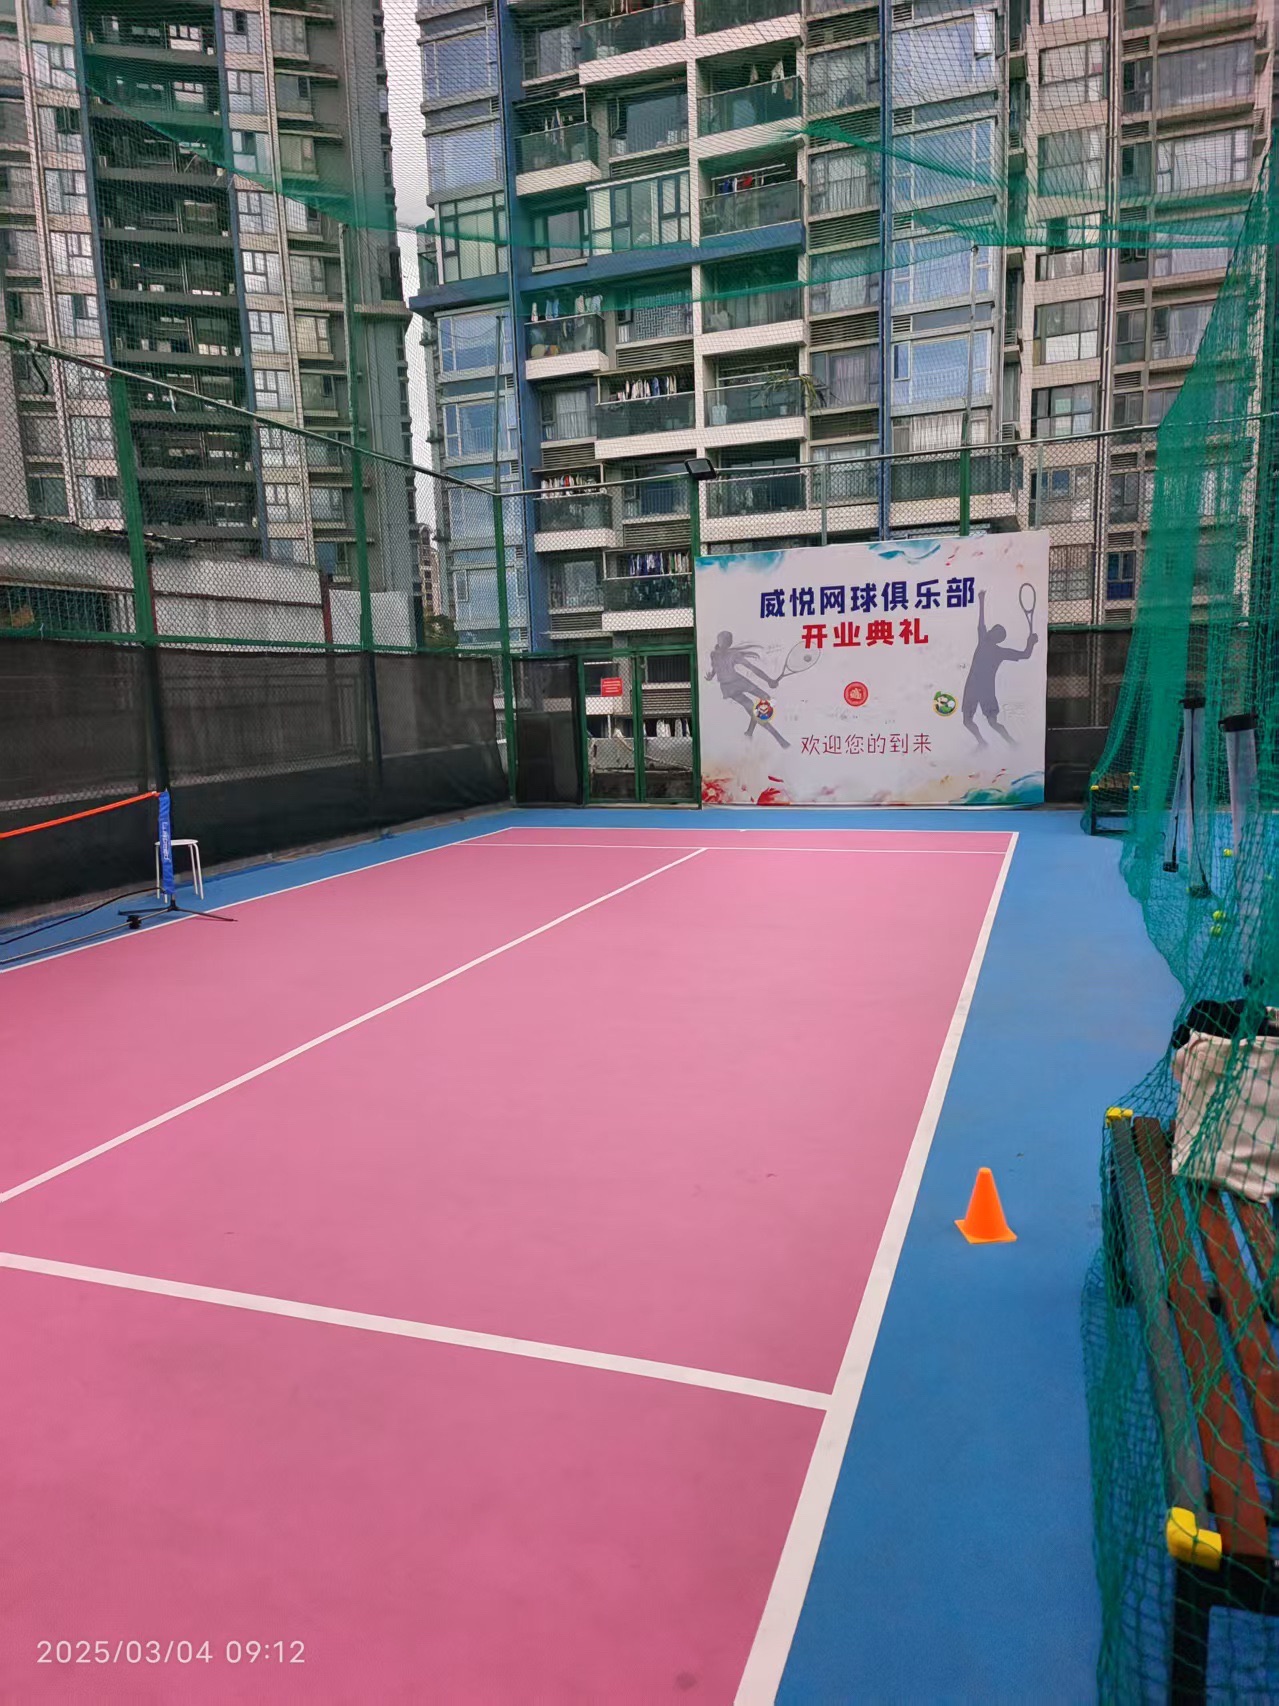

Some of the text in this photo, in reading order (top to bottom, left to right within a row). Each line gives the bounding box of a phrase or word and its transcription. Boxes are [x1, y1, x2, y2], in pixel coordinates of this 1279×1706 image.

[760, 577, 975, 618] 威悦网球俱乐部
[801, 618, 929, 649] 开业典礼
[801, 733, 932, 755] 欢迎您的到来
